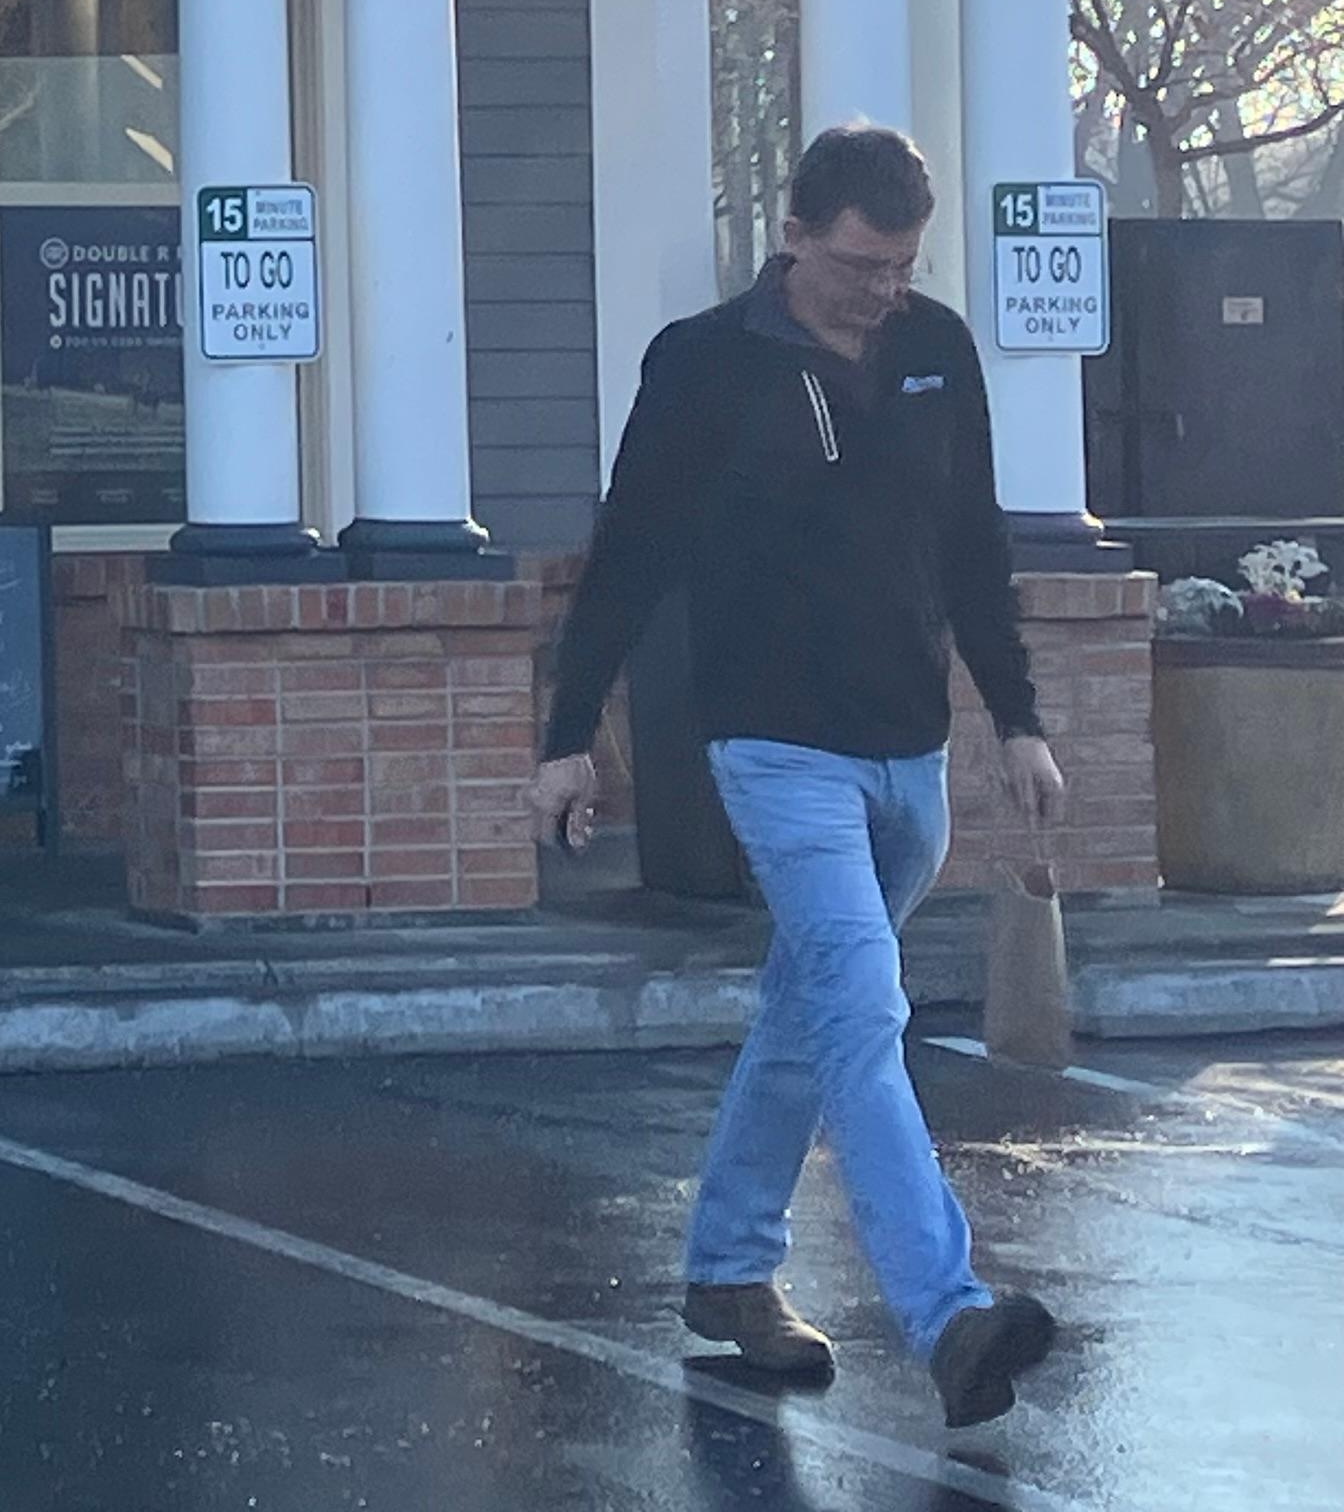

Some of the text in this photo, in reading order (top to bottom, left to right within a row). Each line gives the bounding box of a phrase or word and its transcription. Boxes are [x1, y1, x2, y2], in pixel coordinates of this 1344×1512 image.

[206, 196, 244, 233] 15
[255, 199, 303, 216] MINUTE
[1000, 192, 1034, 228] 15
[253, 217, 309, 231] PARKING
[71, 244, 151, 263] DOUBLE
[220, 250, 294, 290] TO GO
[1012, 245, 1082, 284] TO GO
[48, 271, 186, 329] SIGNATU
[1005, 296, 1098, 314] PARKING
[211, 301, 310, 321] PARKING
[233, 323, 292, 342] ONLY
[1024, 316, 1081, 335] ONLY
